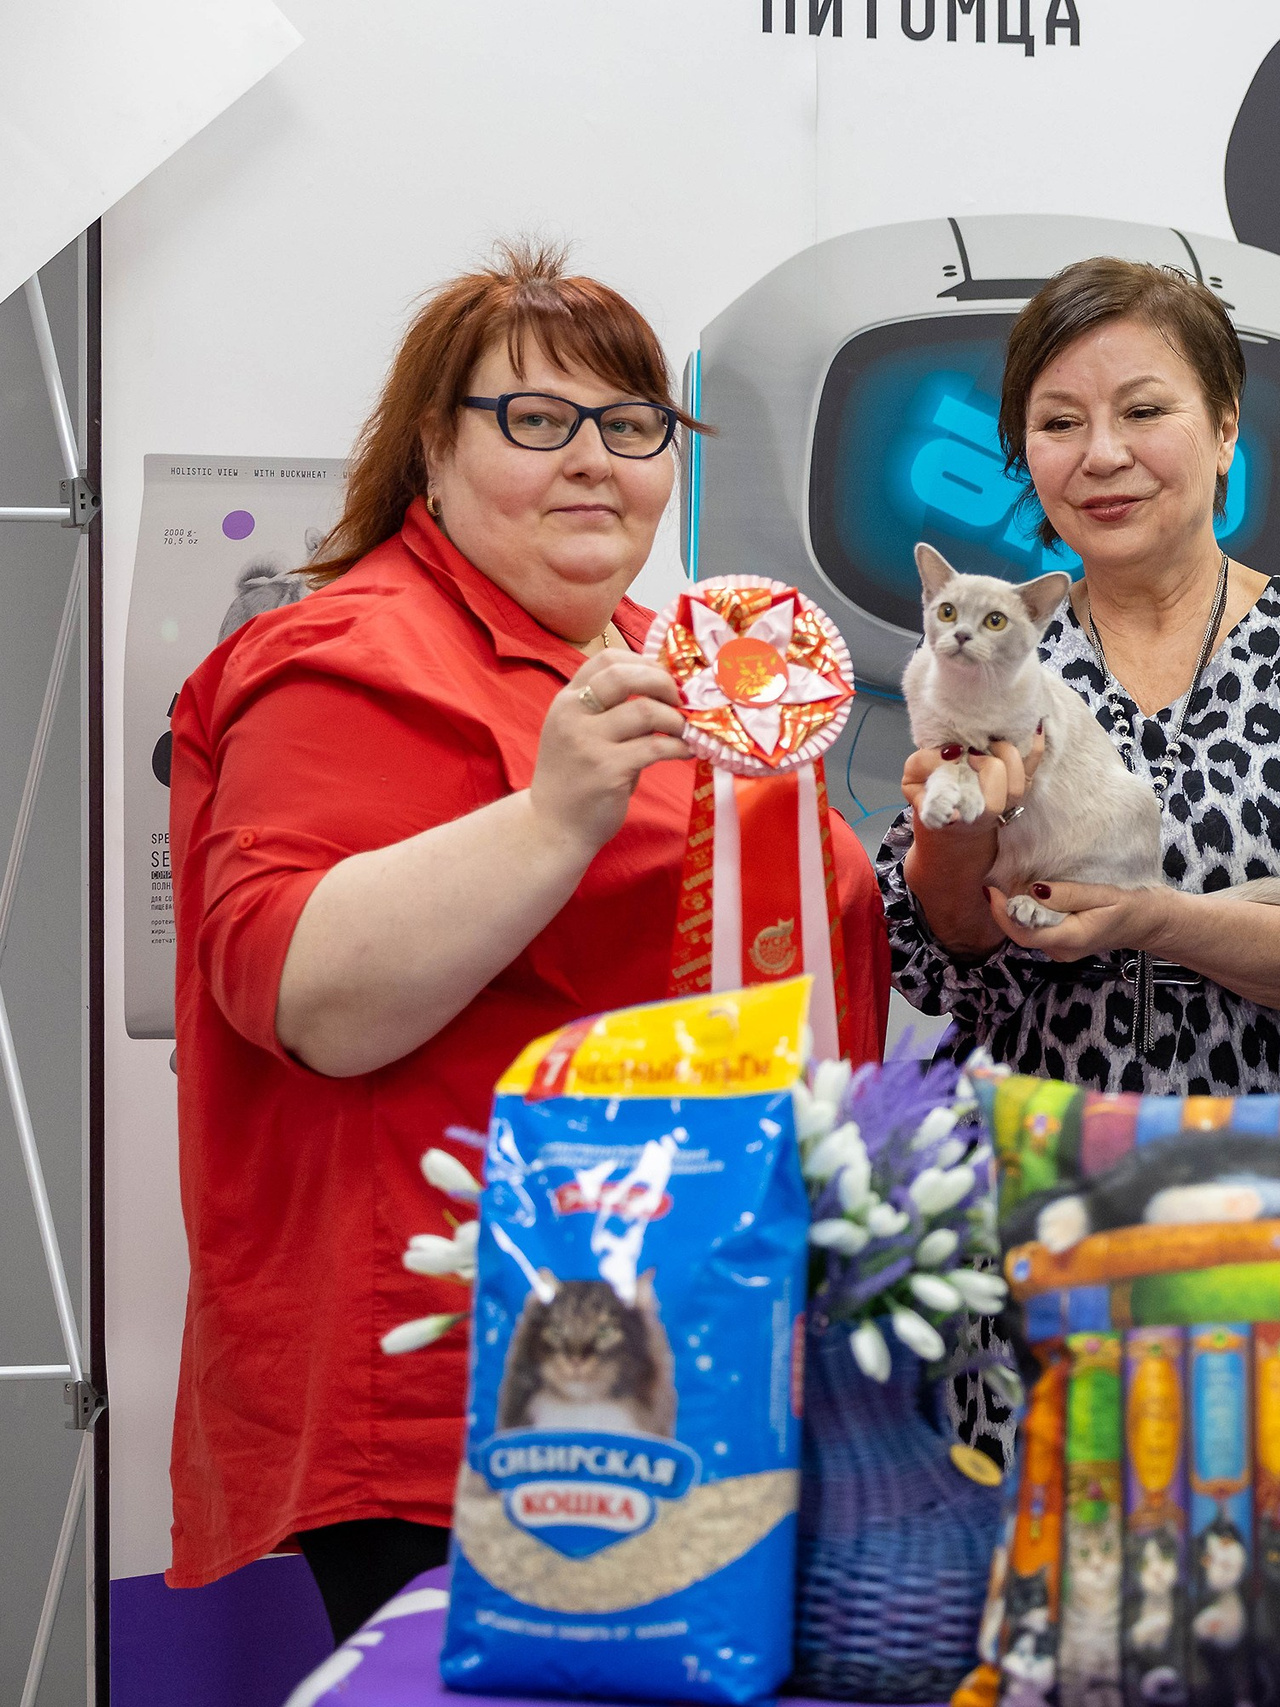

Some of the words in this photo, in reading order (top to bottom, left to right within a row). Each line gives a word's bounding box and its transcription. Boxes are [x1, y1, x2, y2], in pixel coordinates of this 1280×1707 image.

[170, 467, 212, 476] HOLISTIC
[218, 468, 239, 477] VIEW
[254, 469, 275, 478] WITH
[280, 470, 327, 479] BUCKWHEAT
[164, 528, 184, 537] 2000
[151, 881, 173, 891] ПОЛН
[489, 1444, 678, 1487] СИБИРСКАЯ
[520, 1488, 636, 1522] КОШКА
